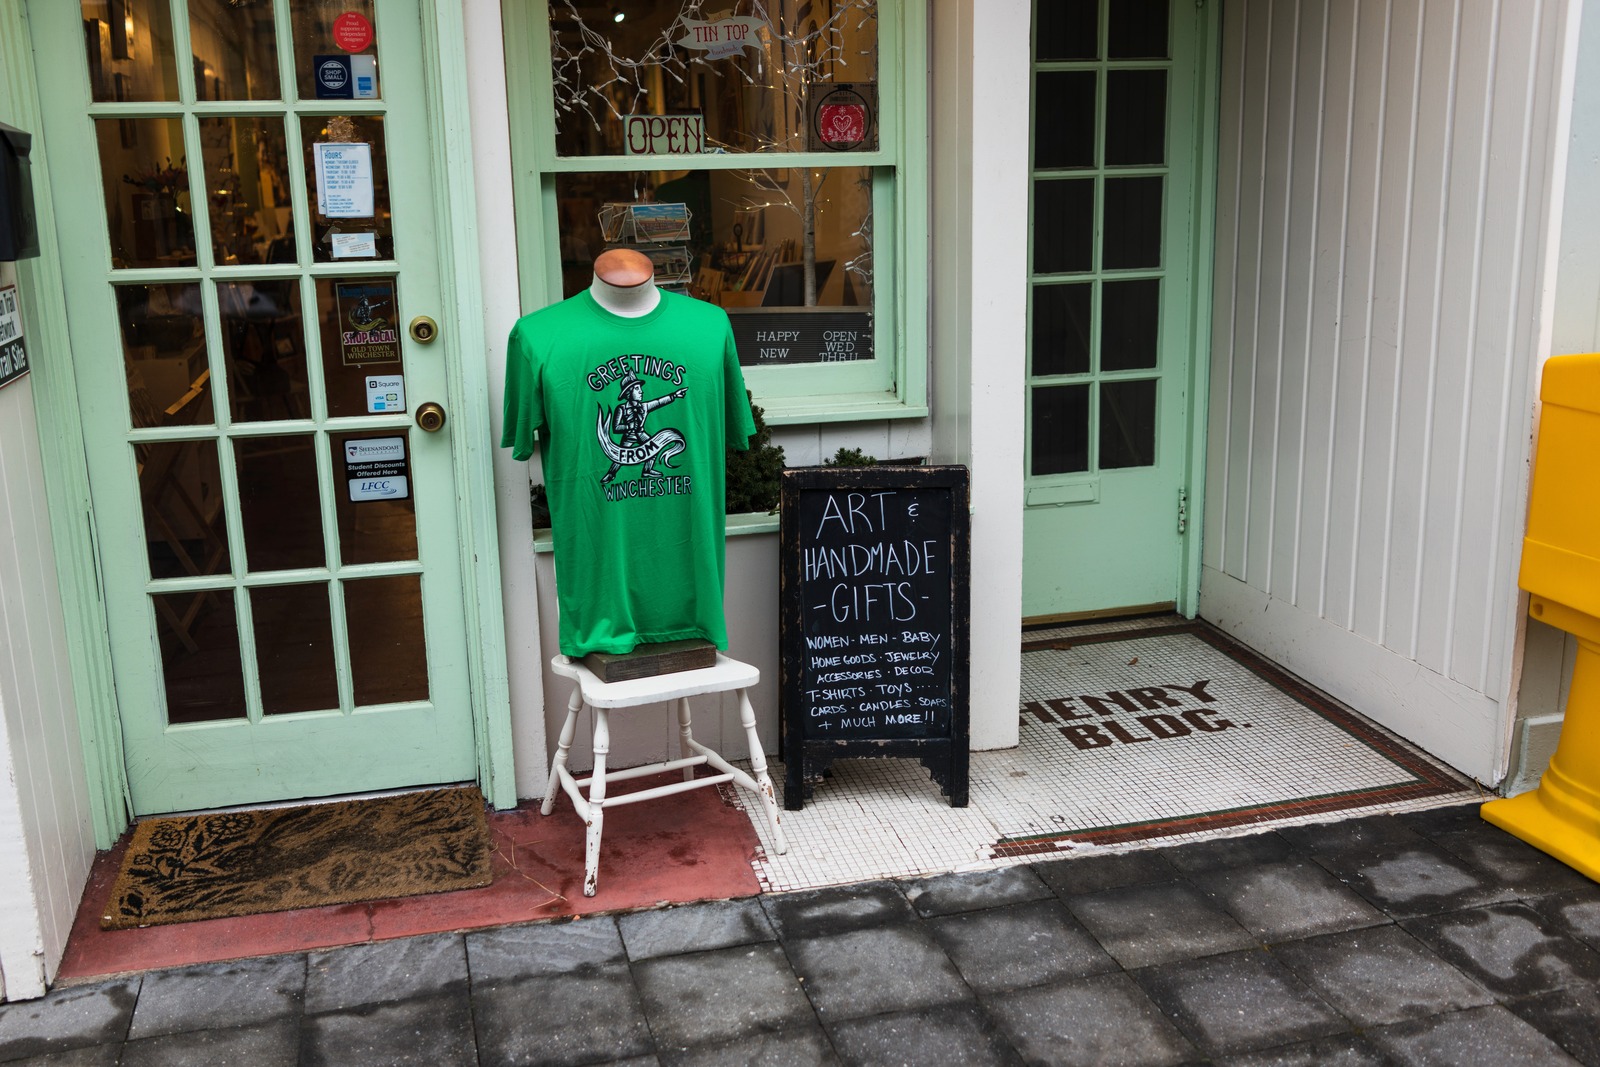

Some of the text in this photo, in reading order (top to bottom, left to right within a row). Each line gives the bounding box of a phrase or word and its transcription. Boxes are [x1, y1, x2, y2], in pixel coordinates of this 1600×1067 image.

[693, 24, 749, 42] TIN TOP
[627, 117, 703, 154] OPEN
[324, 150, 343, 159] HOURS
[343, 329, 396, 345] SHOP LOCAL
[756, 331, 800, 342] HAPPY
[822, 330, 858, 341] OPEN
[347, 351, 395, 359] WINCHESTER
[760, 348, 790, 359] NEW
[825, 342, 855, 352] WED
[0, 343, 26, 379] rail Site
[819, 352, 859, 362] THRU
[587, 354, 686, 391] GREETINGS
[618, 439, 660, 464] FROM
[347, 461, 406, 471] Student Discounts
[361, 480, 390, 491] LFCC
[602, 475, 692, 502] WINCHESTER
[815, 491, 897, 540] ART
[804, 539, 937, 582] HANDMADE
[806, 631, 940, 651] WOMEN MEN BABY
[885, 651, 940, 666] JEWELRY
[816, 666, 934, 684] ACCESSORIES DECOR
[805, 682, 912, 702] T-SHIRTS TOYS
[810, 697, 947, 717] CARDS CANDLES SOAPS
[1019, 679, 1218, 727] HENRY
[841, 716, 876, 729] MUCH
[1058, 708, 1252, 750] BLDG.
